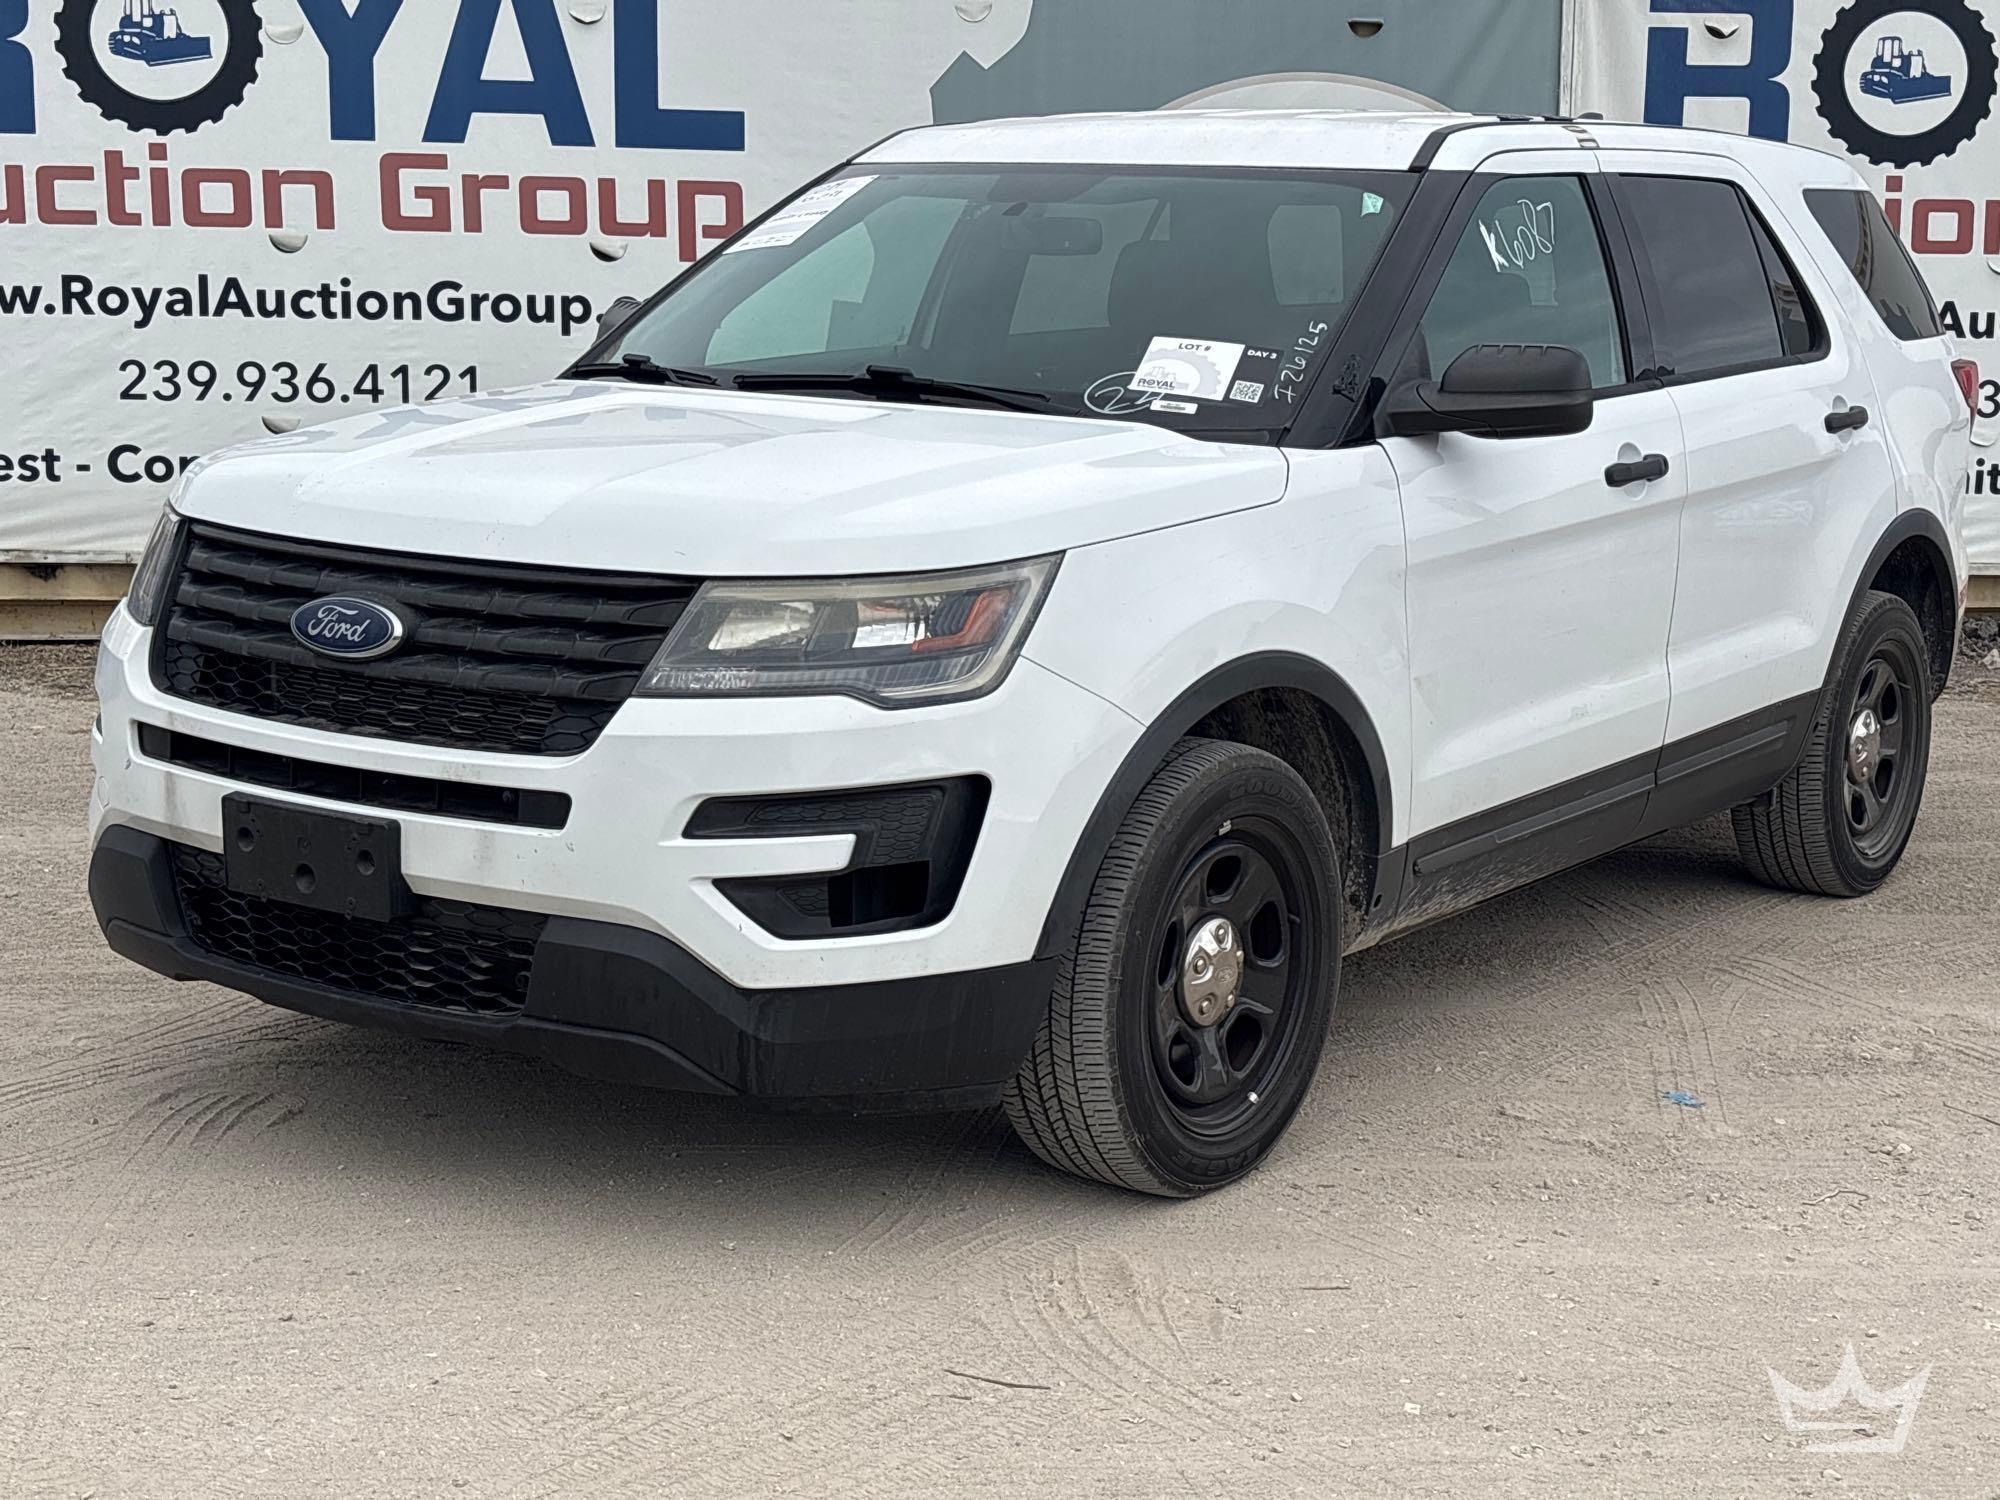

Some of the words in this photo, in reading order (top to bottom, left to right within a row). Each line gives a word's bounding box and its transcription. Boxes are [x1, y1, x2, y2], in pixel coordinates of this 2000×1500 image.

[380, 153, 744, 262] Group
[1884, 175, 2000, 255] io
[1178, 343, 1202, 351] LOT
[1247, 349, 1268, 358] DAY
[118, 359, 478, 404] 239.936.4121
[307, 605, 371, 642] Ford
